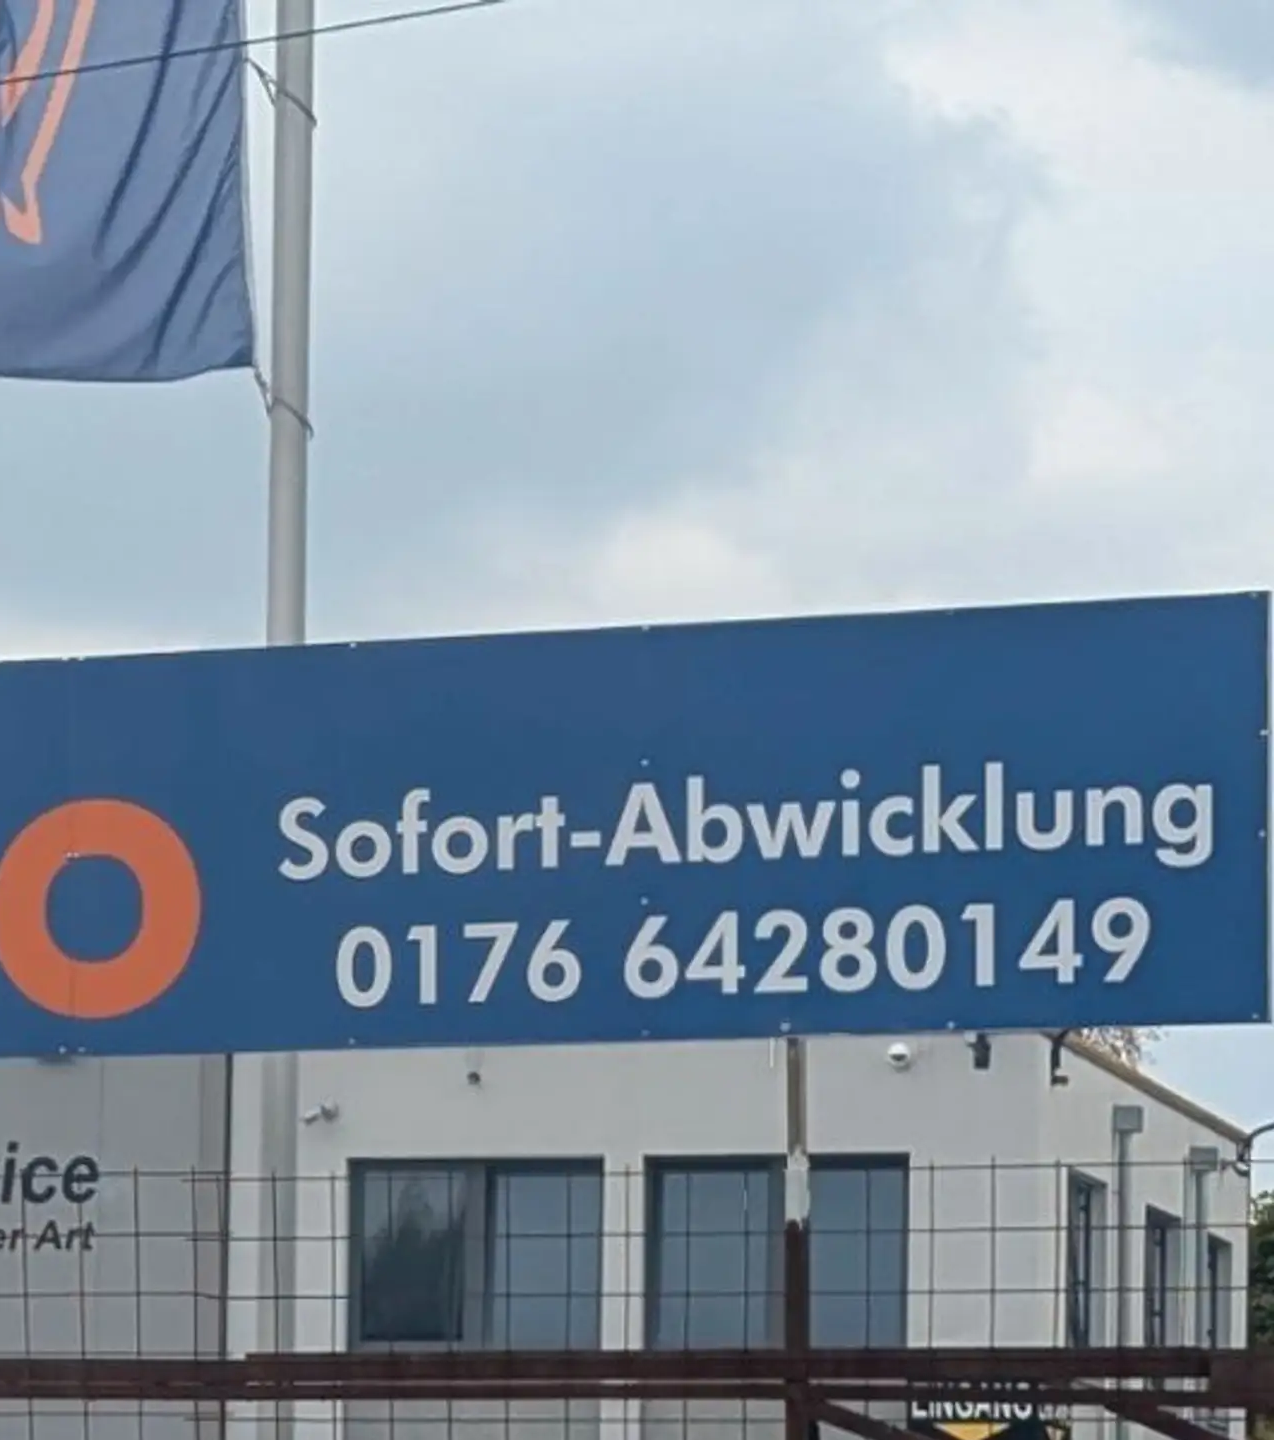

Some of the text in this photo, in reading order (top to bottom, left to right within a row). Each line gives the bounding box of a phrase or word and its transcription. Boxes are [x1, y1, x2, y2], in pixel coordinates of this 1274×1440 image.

[278, 762, 1213, 880] Sofort-Abwicklung
[336, 897, 1150, 1007] 0176 64280149
[34, 1219, 95, 1251] Art
